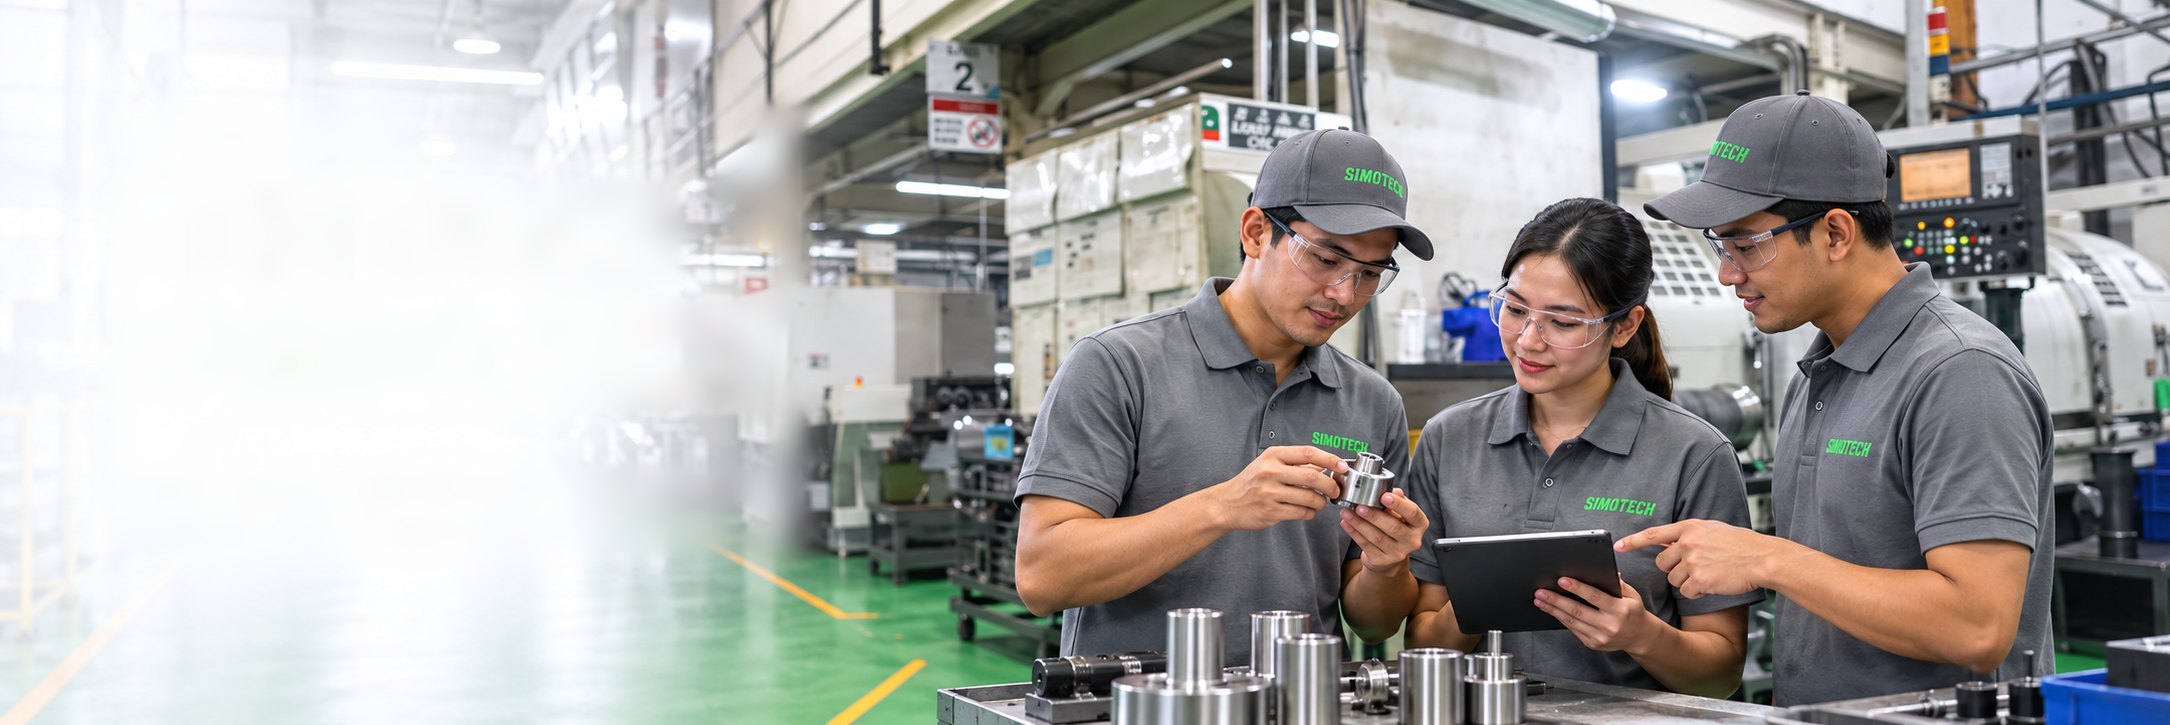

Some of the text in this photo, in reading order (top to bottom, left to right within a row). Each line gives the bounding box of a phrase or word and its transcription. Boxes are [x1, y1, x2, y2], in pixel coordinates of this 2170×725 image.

[954, 61, 973, 91] 2
[1311, 431, 1369, 453] SIMOTECH
[1826, 438, 1872, 458] SIMOTECH
[1583, 496, 1657, 516] SIMOTECH
